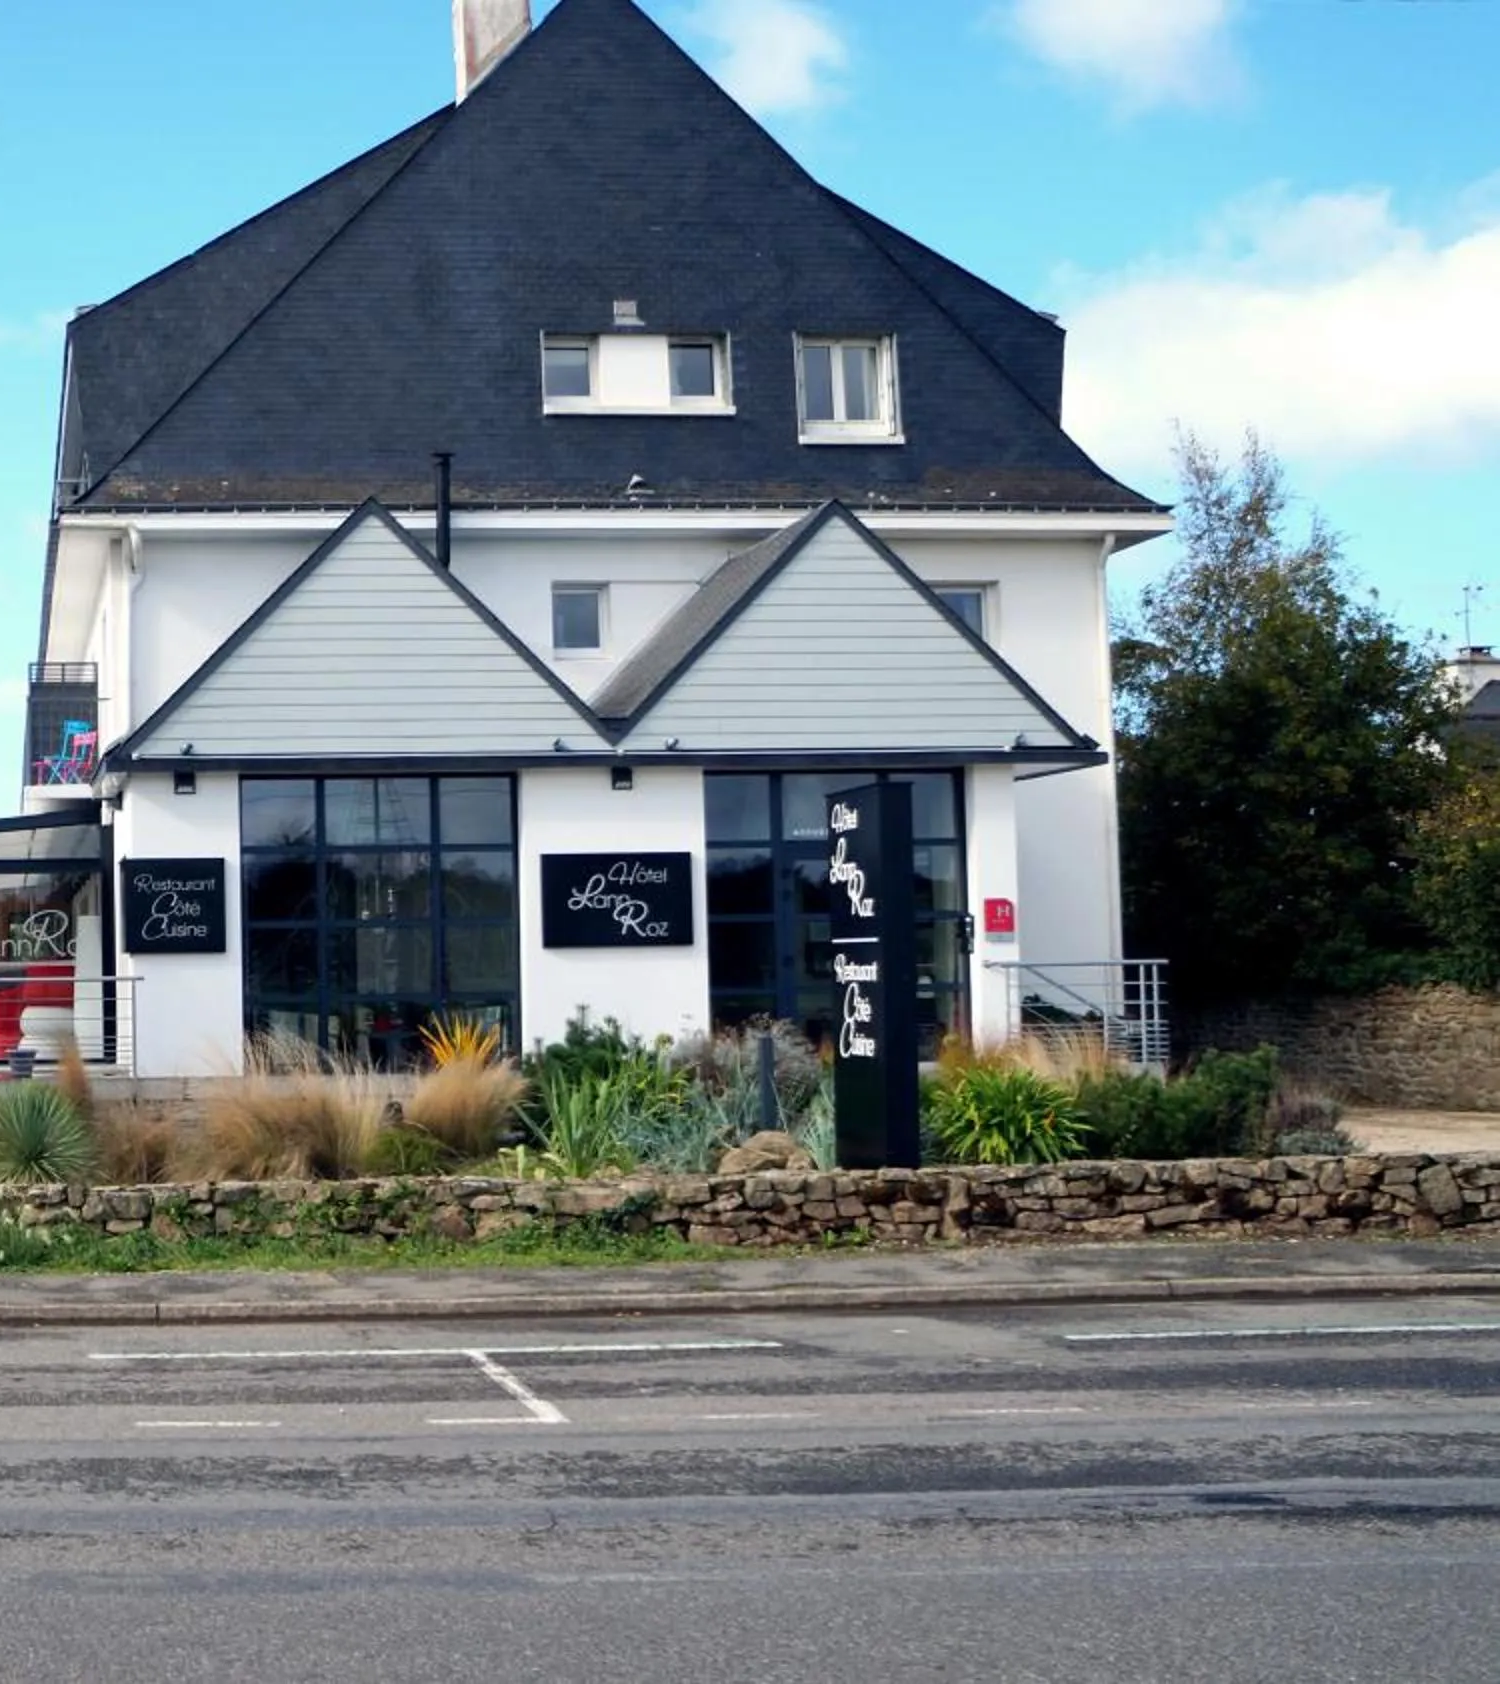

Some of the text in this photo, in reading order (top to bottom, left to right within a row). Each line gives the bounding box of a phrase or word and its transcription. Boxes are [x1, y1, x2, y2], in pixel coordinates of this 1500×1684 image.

[133, 873, 215, 894] Restaurant
[608, 861, 668, 885] Hôtel
[151, 892, 201, 917] Côté
[567, 874, 632, 911] Lann
[141, 914, 208, 941] Cuisine
[613, 900, 669, 936] Roz
